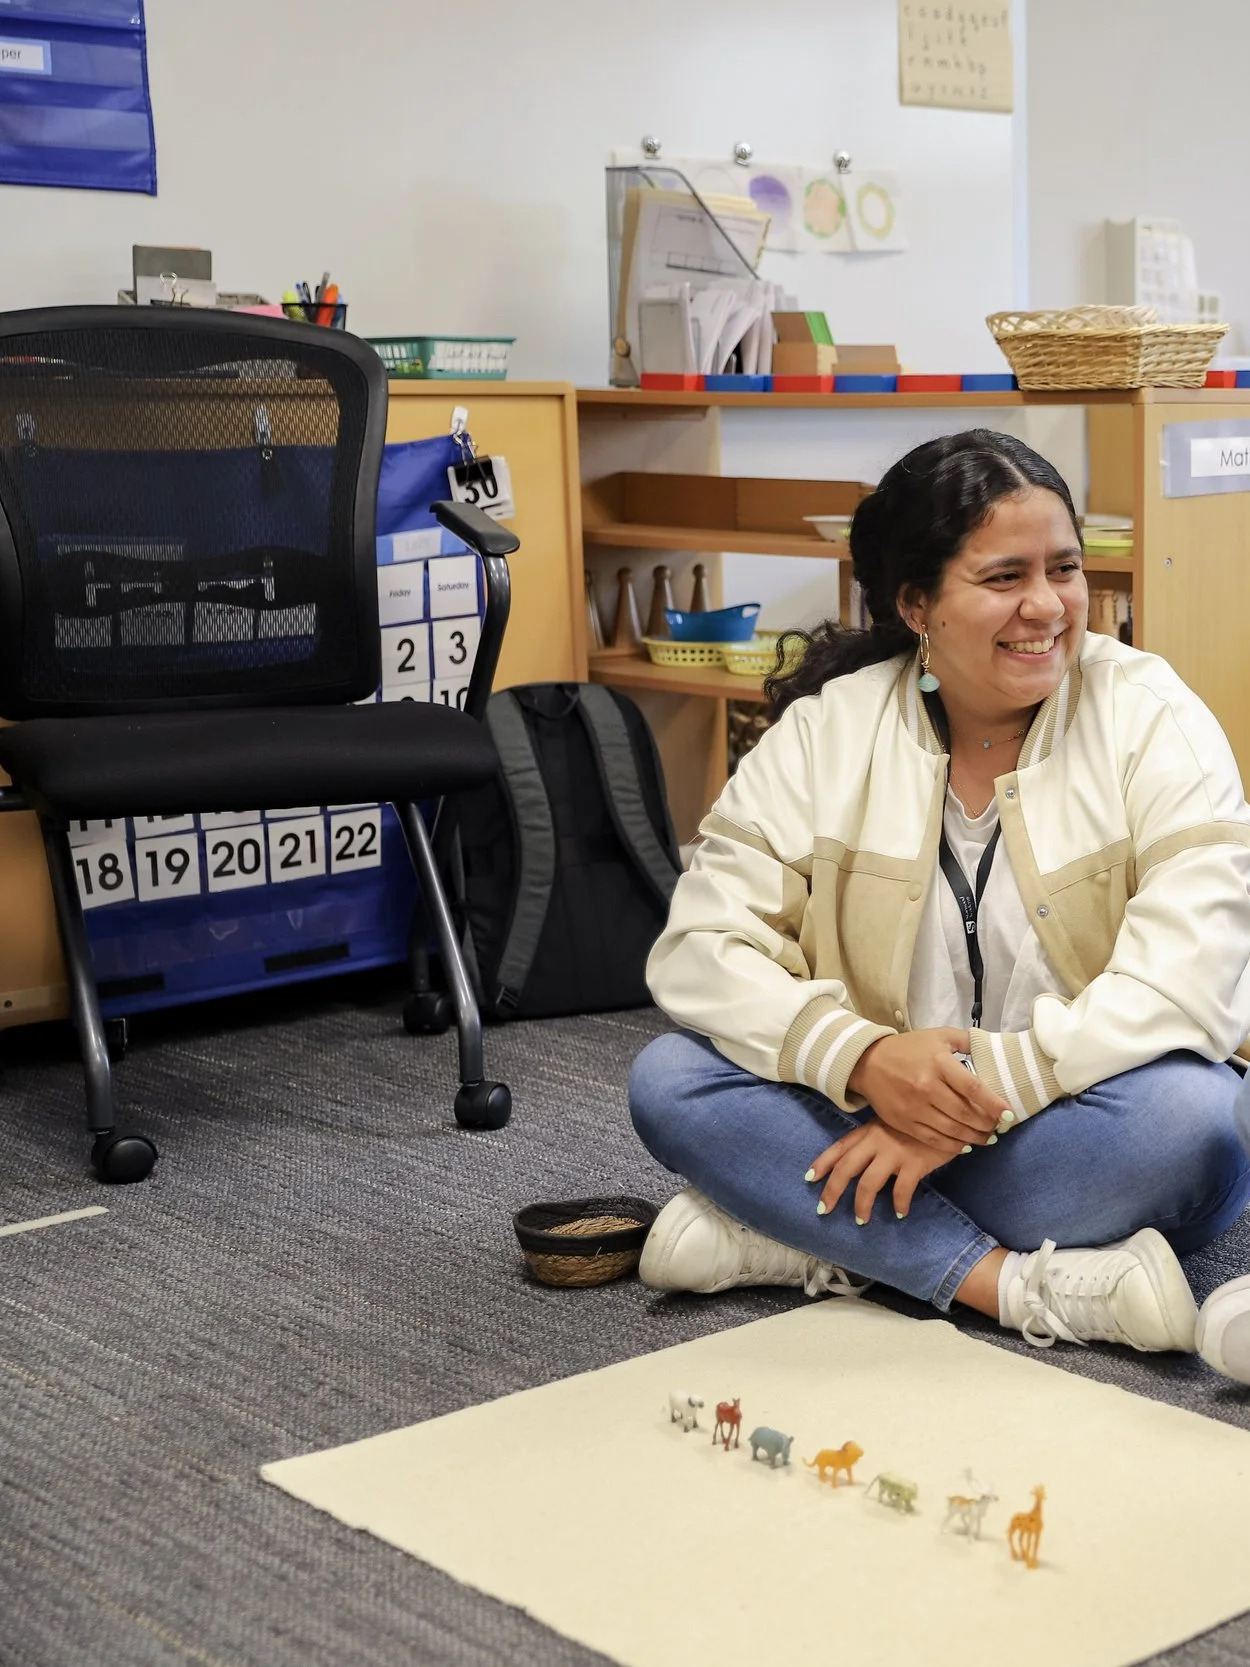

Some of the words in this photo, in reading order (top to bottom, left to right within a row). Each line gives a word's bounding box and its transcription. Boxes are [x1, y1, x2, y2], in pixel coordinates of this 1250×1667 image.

[0, 47, 21, 60] per
[389, 590, 411, 599] Friday
[437, 581, 470, 592] Saturday
[396, 637, 416, 673] 2
[448, 630, 468, 665] 3
[76, 852, 123, 895] 18
[145, 847, 190, 887] 19
[211, 838, 261, 878] 20
[278, 829, 317, 869] 21
[334, 822, 377, 861] 22
